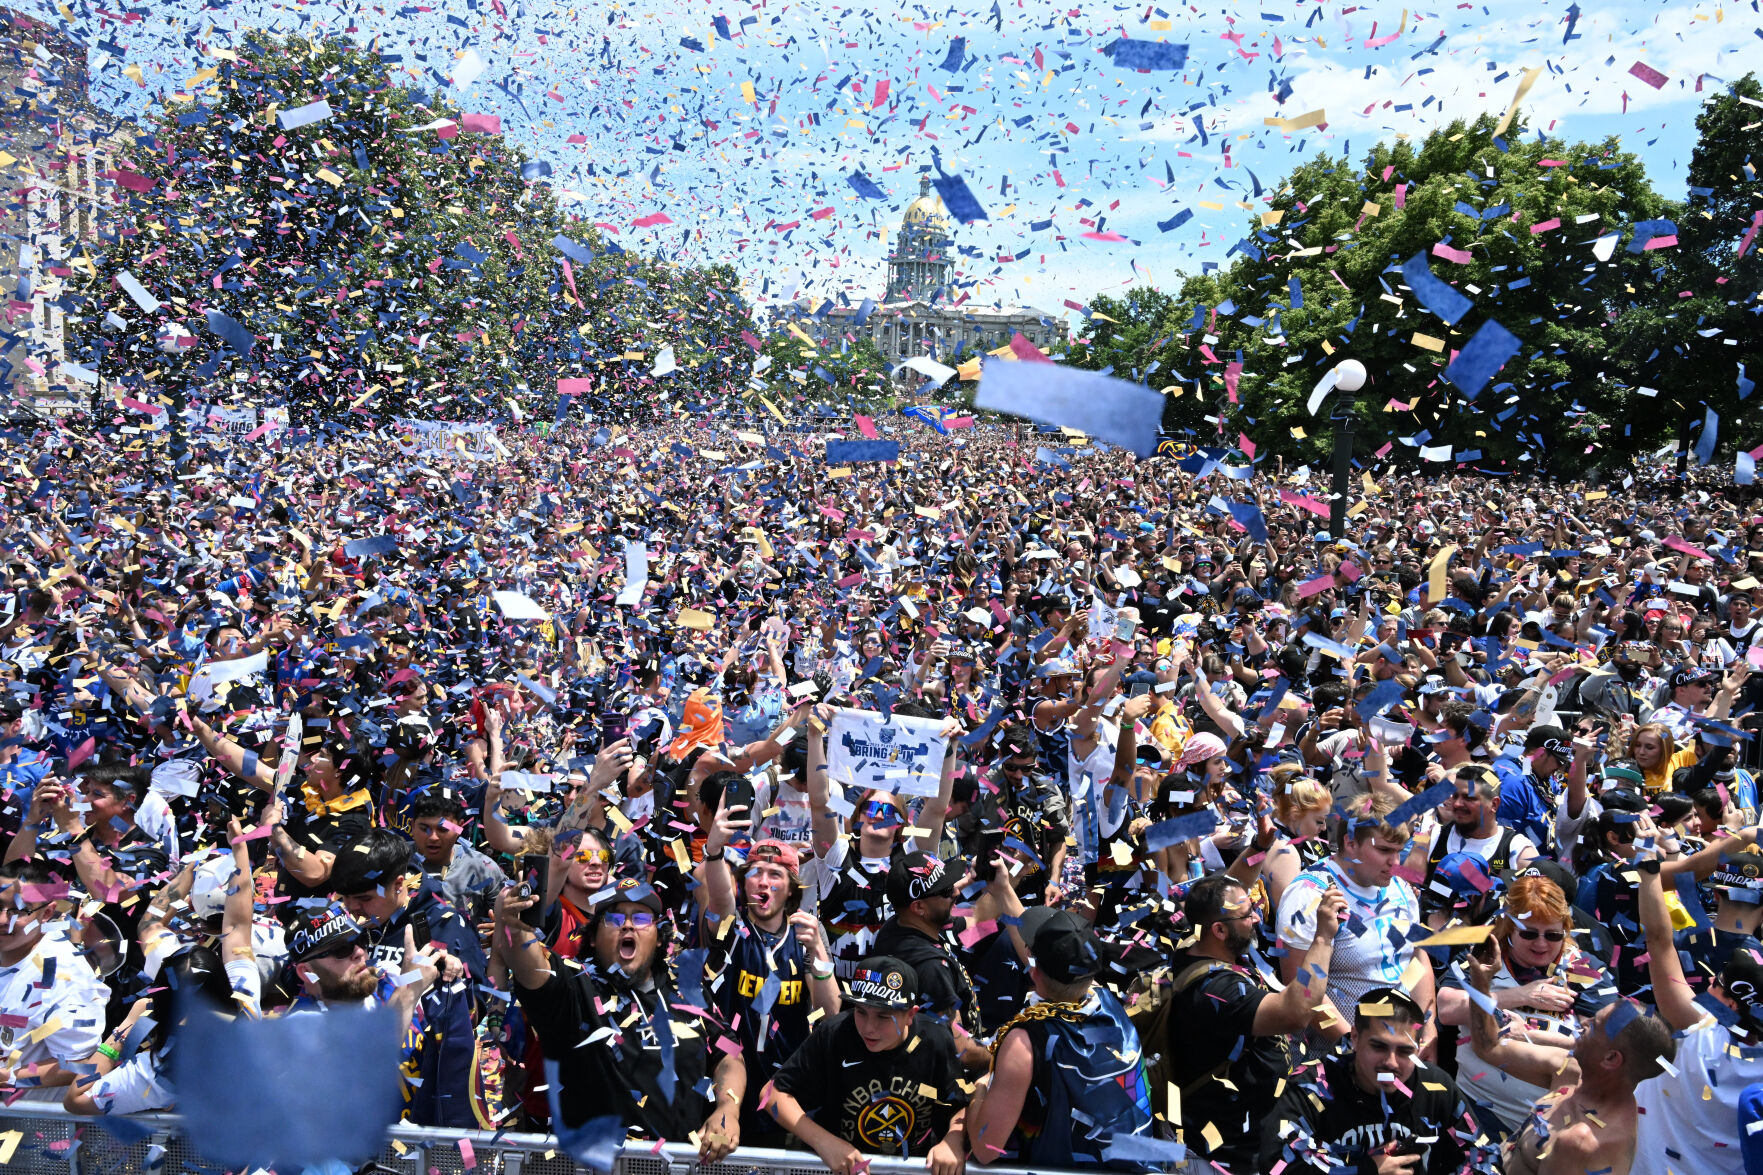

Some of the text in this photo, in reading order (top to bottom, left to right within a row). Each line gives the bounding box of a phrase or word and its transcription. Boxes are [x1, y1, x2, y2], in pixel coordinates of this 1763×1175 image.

[855, 744, 888, 760] BRING
[737, 968, 803, 1006] DENER
[842, 1078, 883, 1116] NBA
